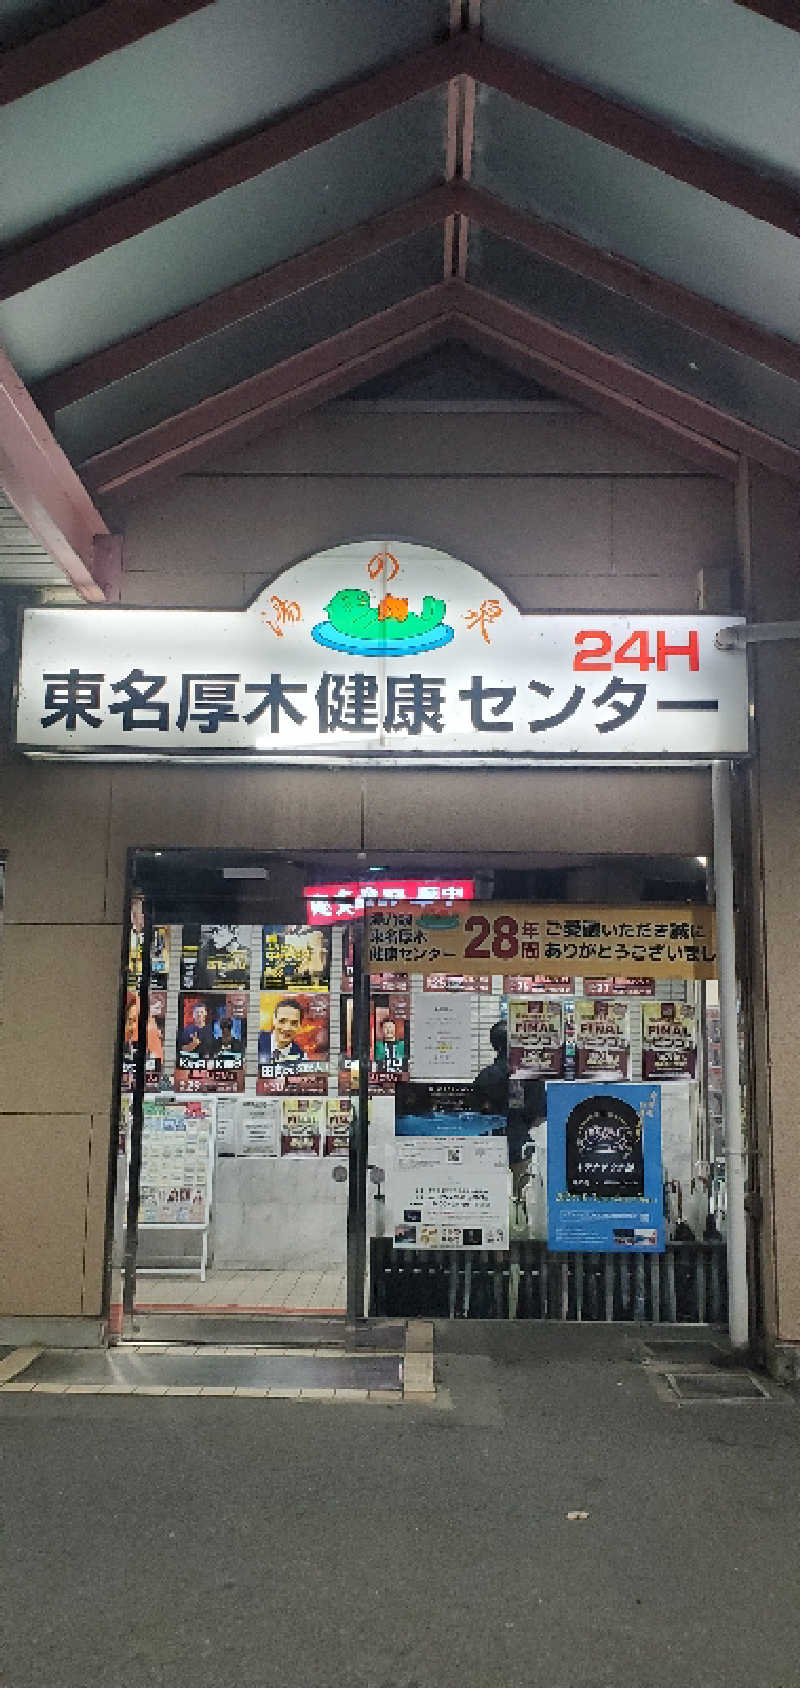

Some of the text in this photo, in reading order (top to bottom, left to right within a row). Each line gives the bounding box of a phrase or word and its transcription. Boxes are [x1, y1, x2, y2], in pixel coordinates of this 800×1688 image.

[573, 630, 699, 672] 24H
[40, 670, 719, 735] 東名厚木健康センター
[464, 915, 519, 959] 28
